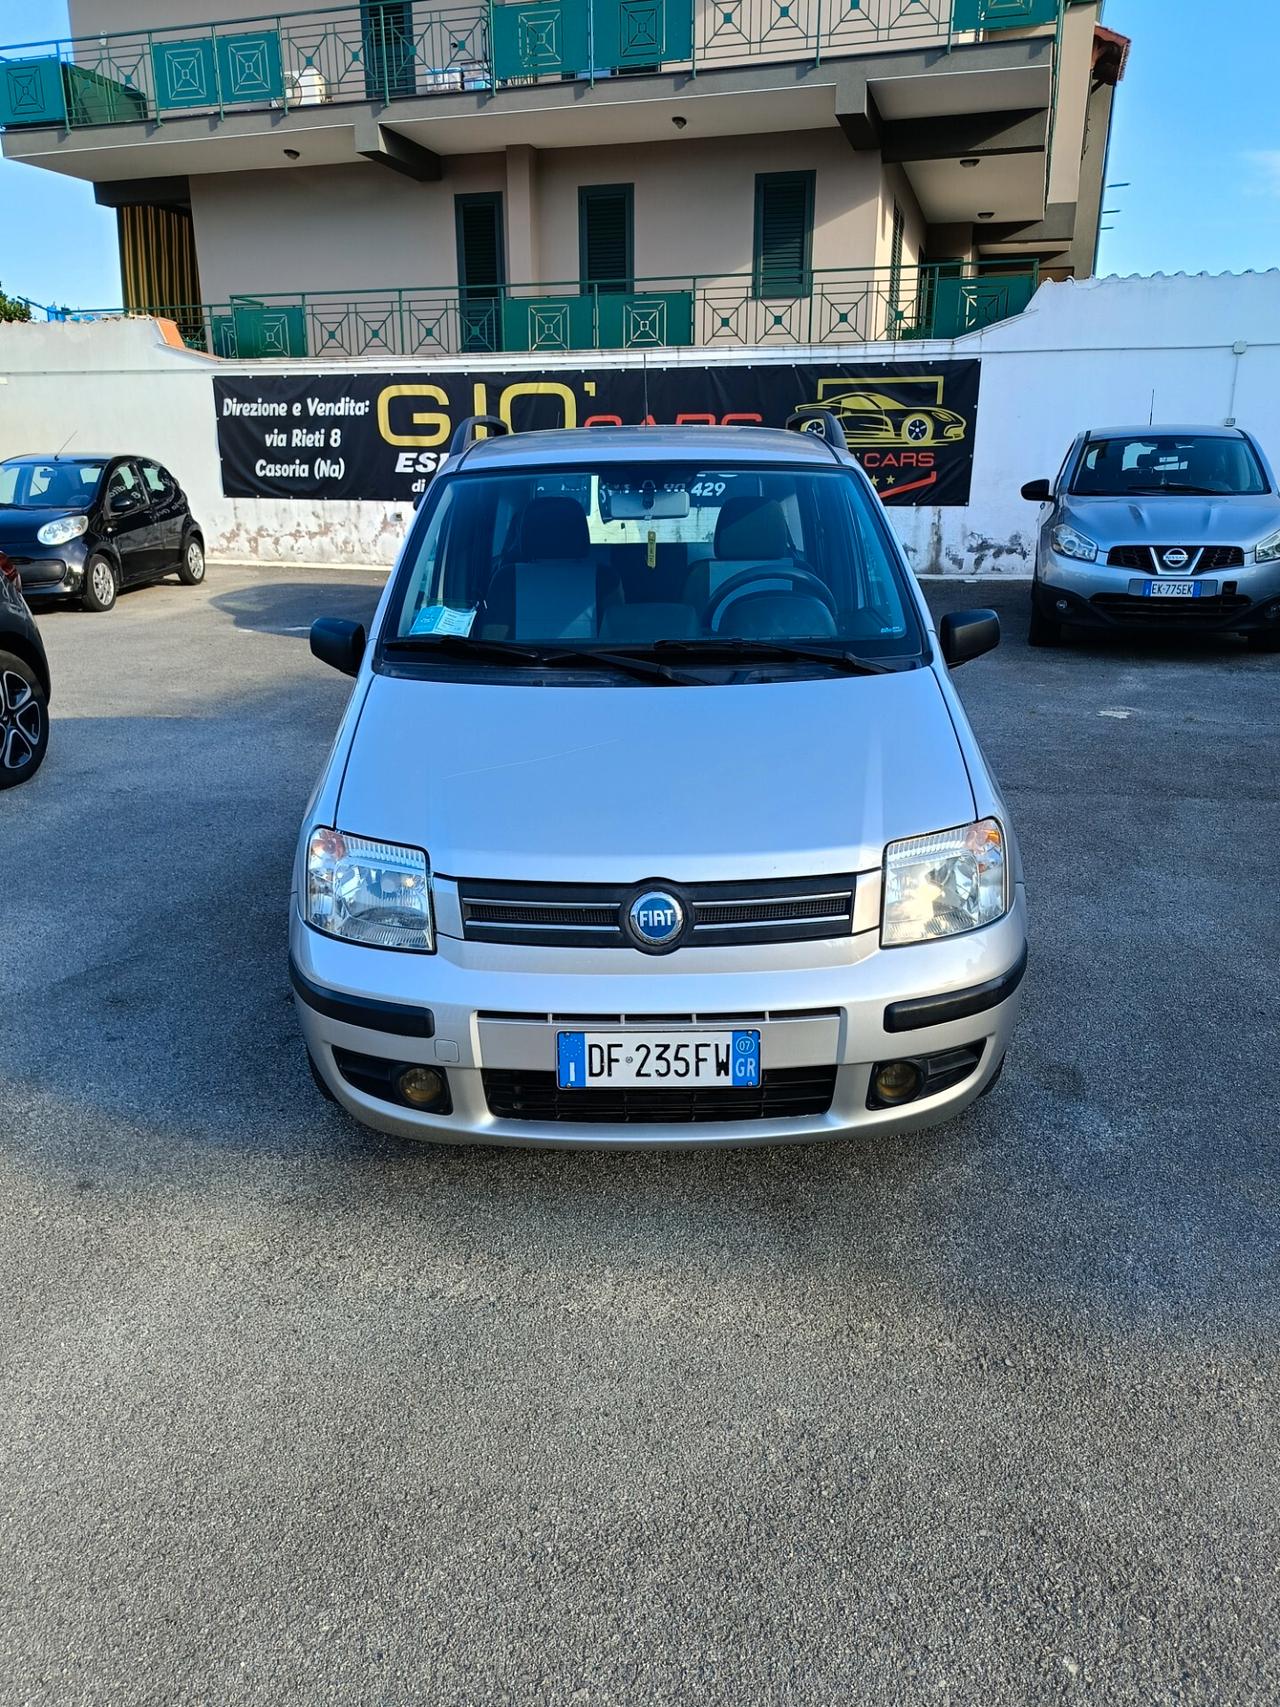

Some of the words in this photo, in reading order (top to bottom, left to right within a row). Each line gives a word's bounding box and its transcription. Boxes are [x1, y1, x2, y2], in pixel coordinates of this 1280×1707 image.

[222, 398, 287, 417] Direzione
[292, 403, 301, 416] e
[306, 396, 370, 417] Vendita:
[265, 430, 287, 448] via
[291, 429, 325, 448] Rieti
[329, 429, 341, 448] 8
[864, 453, 934, 467] CARS
[255, 459, 309, 478] Casoria
[314, 458, 345, 480] (Na)
[411, 479, 426, 492] di
[691, 482, 726, 497] 429
[640, 910, 673, 926] FIAT
[740, 1041, 750, 1050] 07
[635, 1043, 730, 1077] 235FW
[736, 1058, 756, 1077] GR
